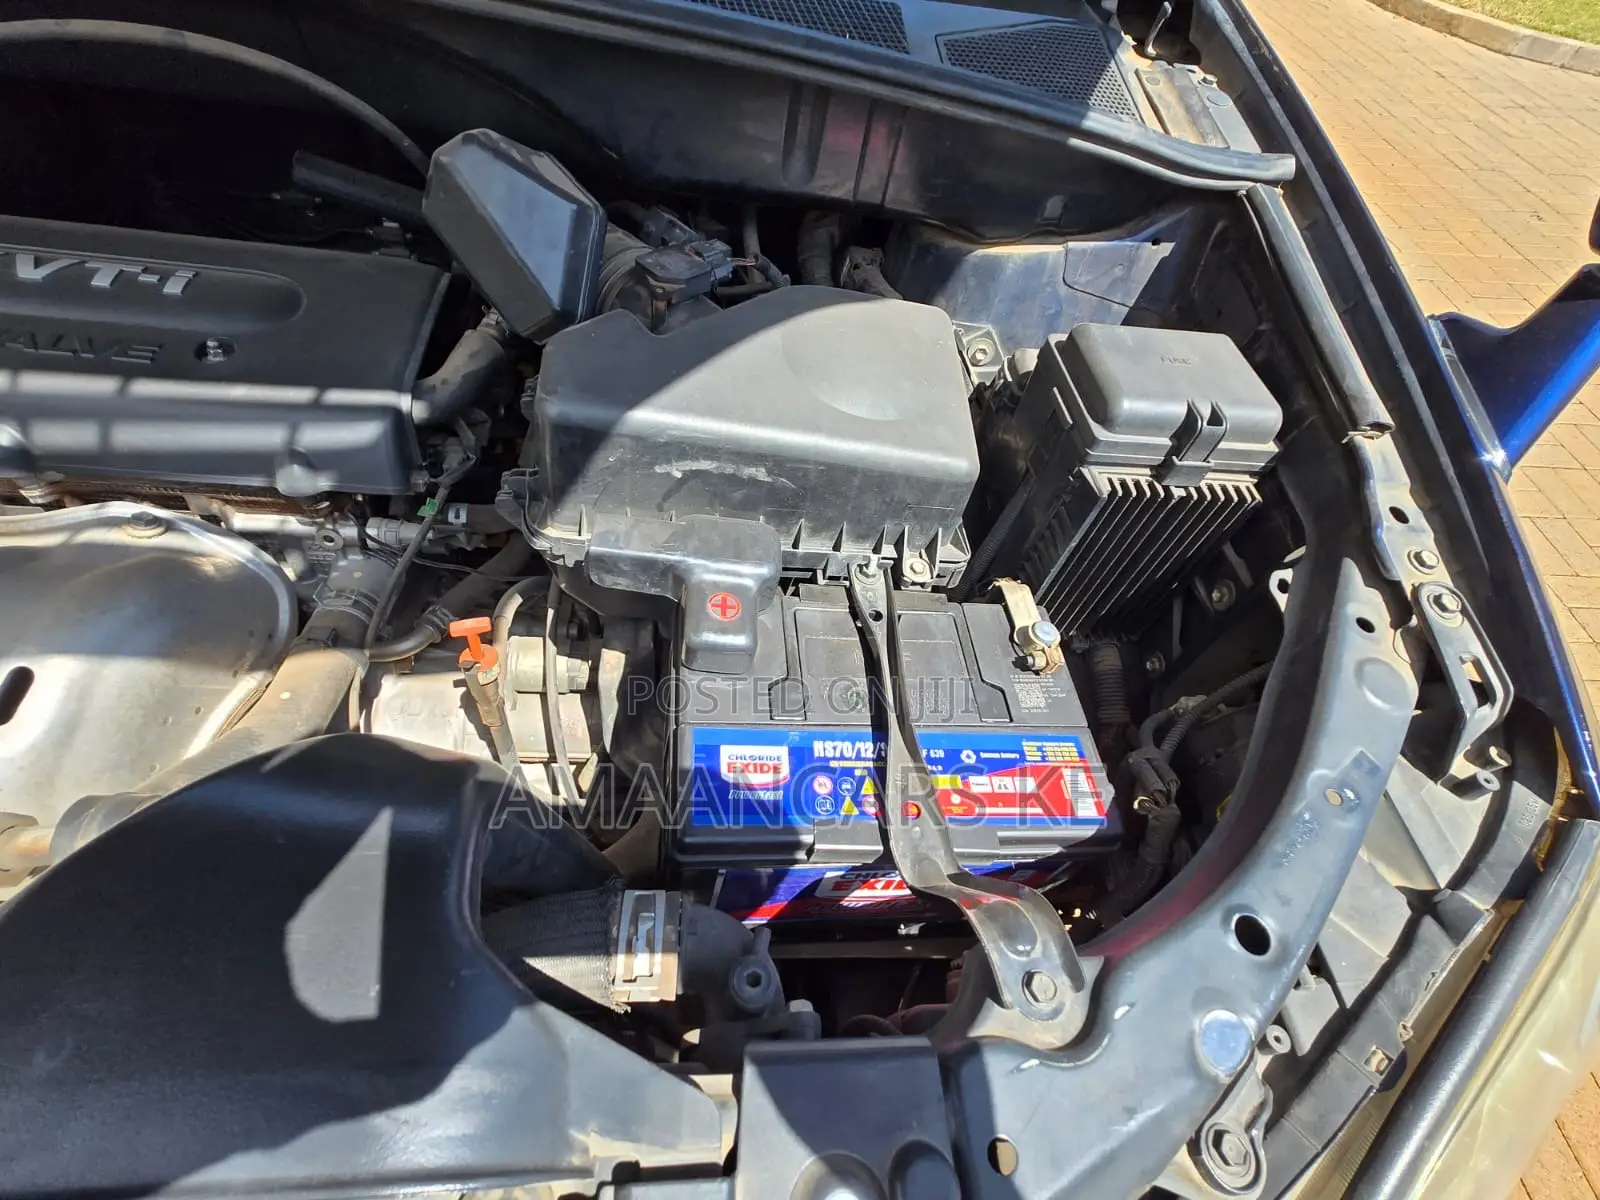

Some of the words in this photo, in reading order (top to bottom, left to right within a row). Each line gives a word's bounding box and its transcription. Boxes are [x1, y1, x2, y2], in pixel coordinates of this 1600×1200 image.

[0, 252, 197, 296] VT-i
[0, 328, 163, 365] ALVE
[1160, 355, 1194, 366] FUSE
[727, 754, 783, 762] CHLORIDE
[726, 762, 784, 775] EXIDE
